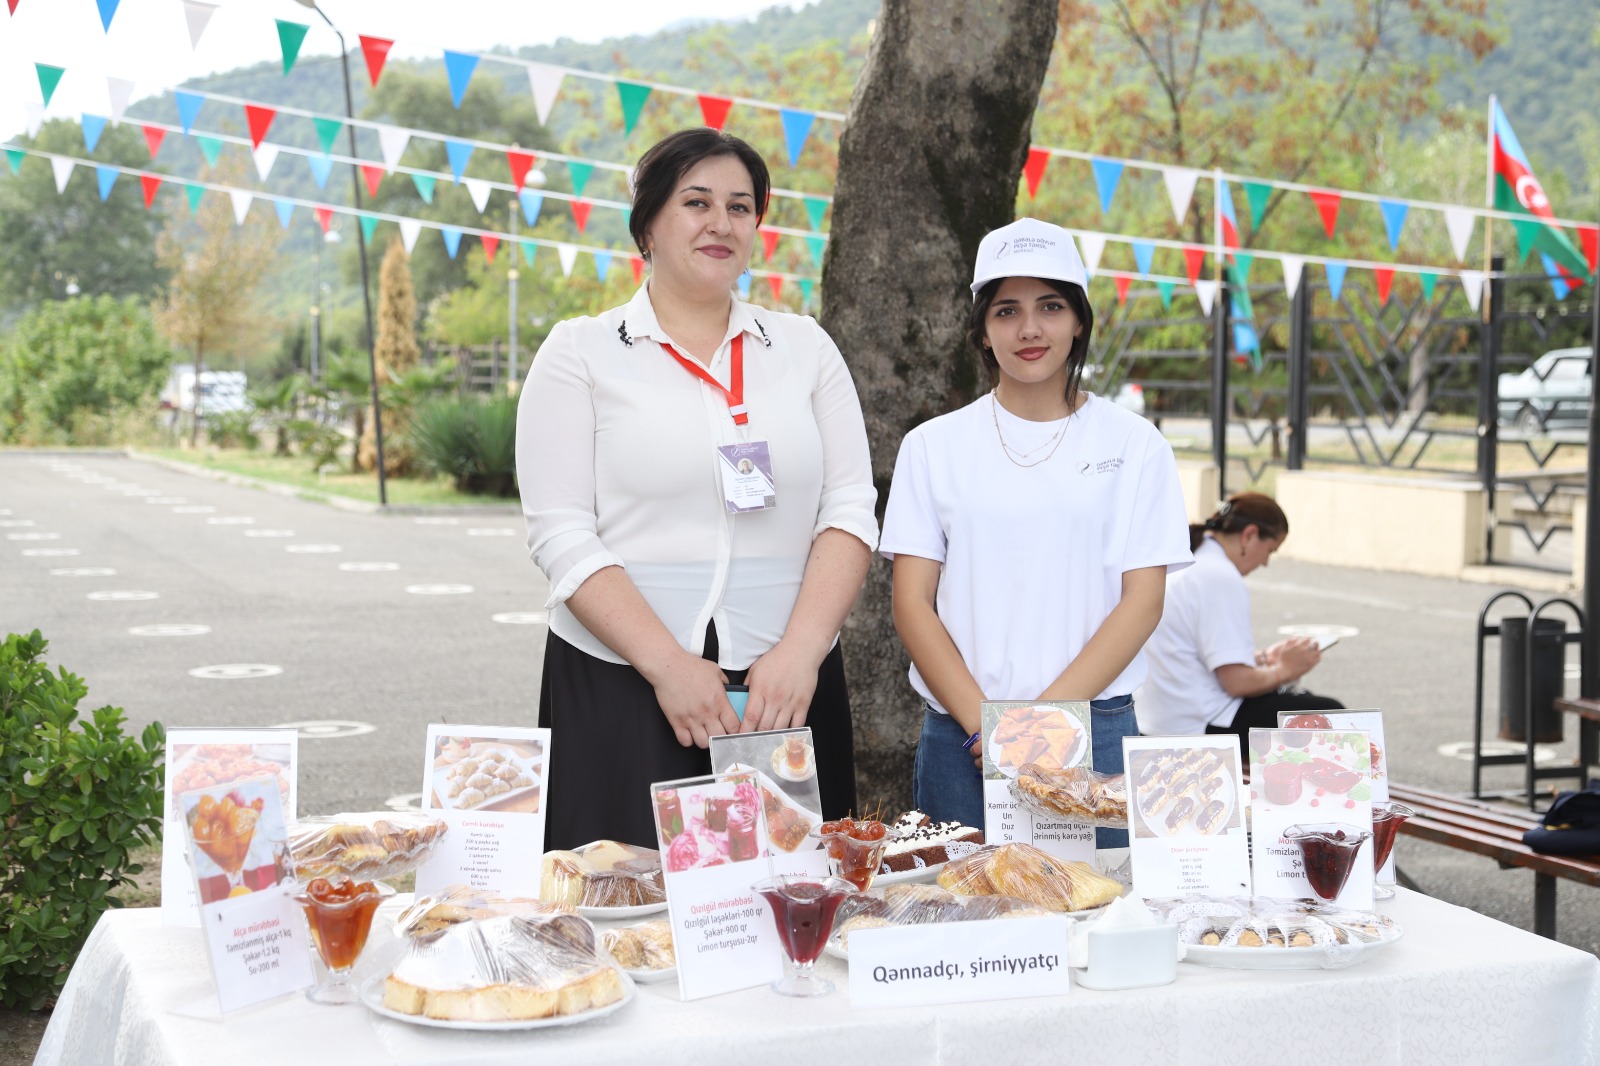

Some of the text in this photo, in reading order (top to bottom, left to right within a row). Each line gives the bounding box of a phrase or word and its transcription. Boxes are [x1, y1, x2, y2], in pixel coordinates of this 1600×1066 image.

[987, 802, 1019, 811] Xəmir üç
[1003, 833, 1013, 841] Su
[1033, 832, 1061, 841] Ərinmiş
[1078, 831, 1094, 841] yağı
[1276, 870, 1300, 878] Limon
[690, 900, 718, 914] Qızılgül
[684, 914, 710, 929] Qızılgül
[755, 907, 763, 918] qr
[233, 927, 247, 938] Alça
[740, 922, 748, 934] qr
[697, 942, 719, 953] Limon
[271, 957, 280, 968] ml
[872, 952, 1060, 984] Qənnadçı, şirniyyatçı
